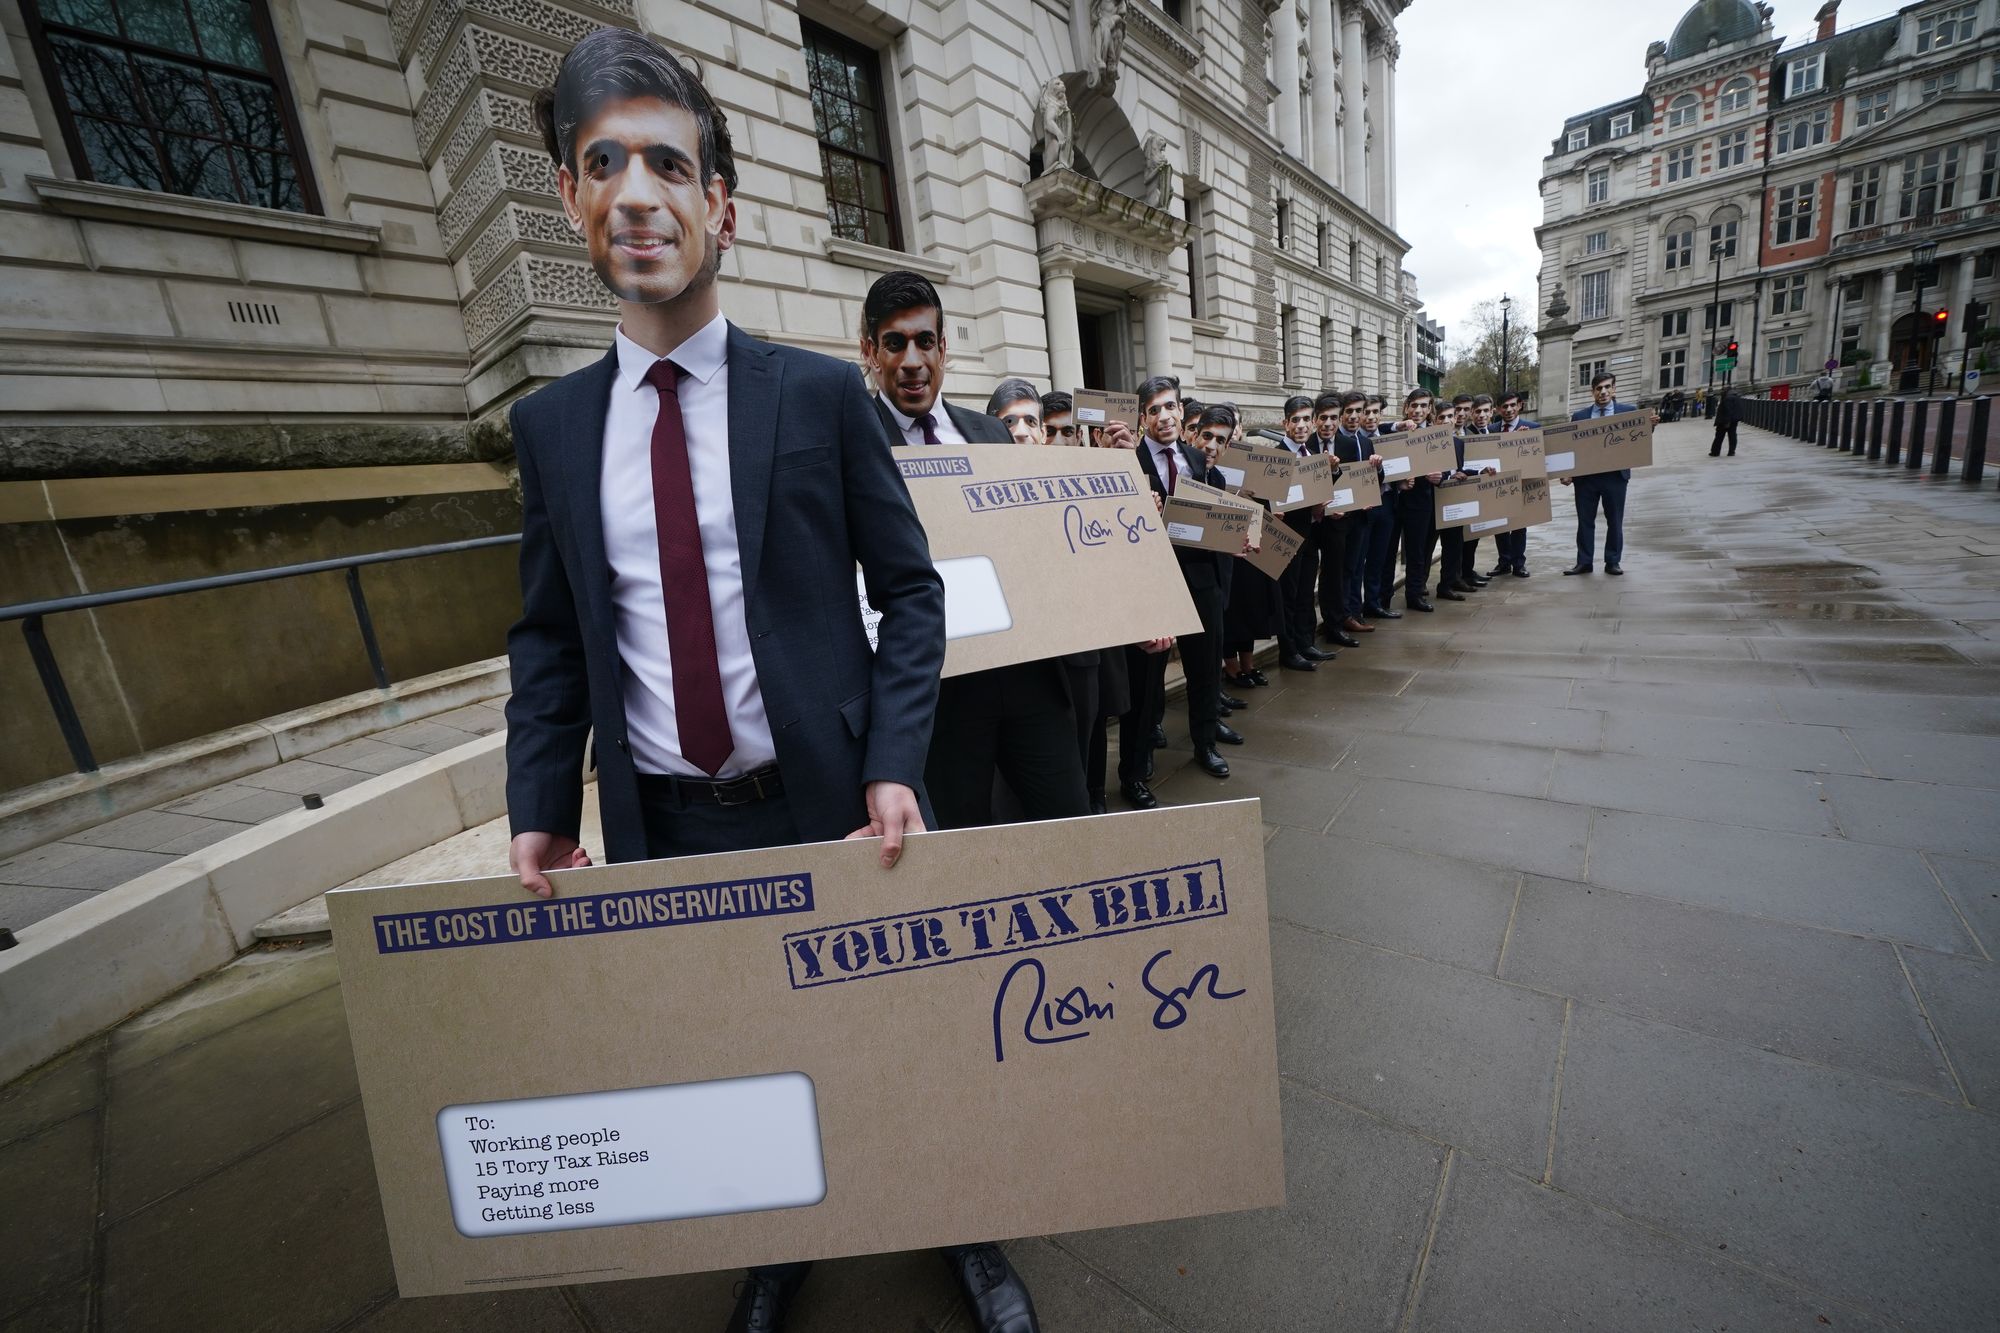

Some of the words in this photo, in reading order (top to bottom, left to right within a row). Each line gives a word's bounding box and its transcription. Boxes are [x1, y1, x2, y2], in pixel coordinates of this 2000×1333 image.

[1573, 427, 1598, 440] YOUR
[1599, 423, 1620, 434] TAX
[1621, 417, 1644, 428] BILL
[1497, 440, 1514, 449] YOUR
[1515, 438, 1527, 446] TAX
[897, 459, 968, 476] ERVATIVES
[1249, 454, 1264, 463] YOUR
[1265, 456, 1277, 464] TAX
[1278, 457, 1292, 466] BILL
[966, 481, 1039, 508] YOUR
[1039, 478, 1088, 499] TAX
[1087, 475, 1134, 495] BILL
[1477, 482, 1494, 491] YOUR
[1494, 479, 1506, 488] TAX
[1506, 475, 1519, 484] BILL
[1207, 512, 1222, 520] YOUR
[379, 916, 430, 948] THE
[436, 911, 500, 943] COST
[506, 907, 537, 937] OF
[543, 902, 596, 932] THE
[601, 878, 807, 927] CONSERVATIVES
[791, 912, 951, 979] YOUR
[960, 892, 1081, 951] TAX
[1091, 871, 1219, 928] BILL
[465, 1116, 496, 1131] To:
[469, 1133, 553, 1155] Working
[556, 1127, 621, 1150] people
[475, 1161, 498, 1177] 15
[502, 1156, 549, 1178] Tory
[554, 1154, 593, 1170] Tax
[596, 1148, 650, 1167] Rises
[477, 1180, 545, 1201] Paying
[548, 1176, 600, 1194] more
[481, 1202, 554, 1222] Getting
[557, 1199, 595, 1216] less
